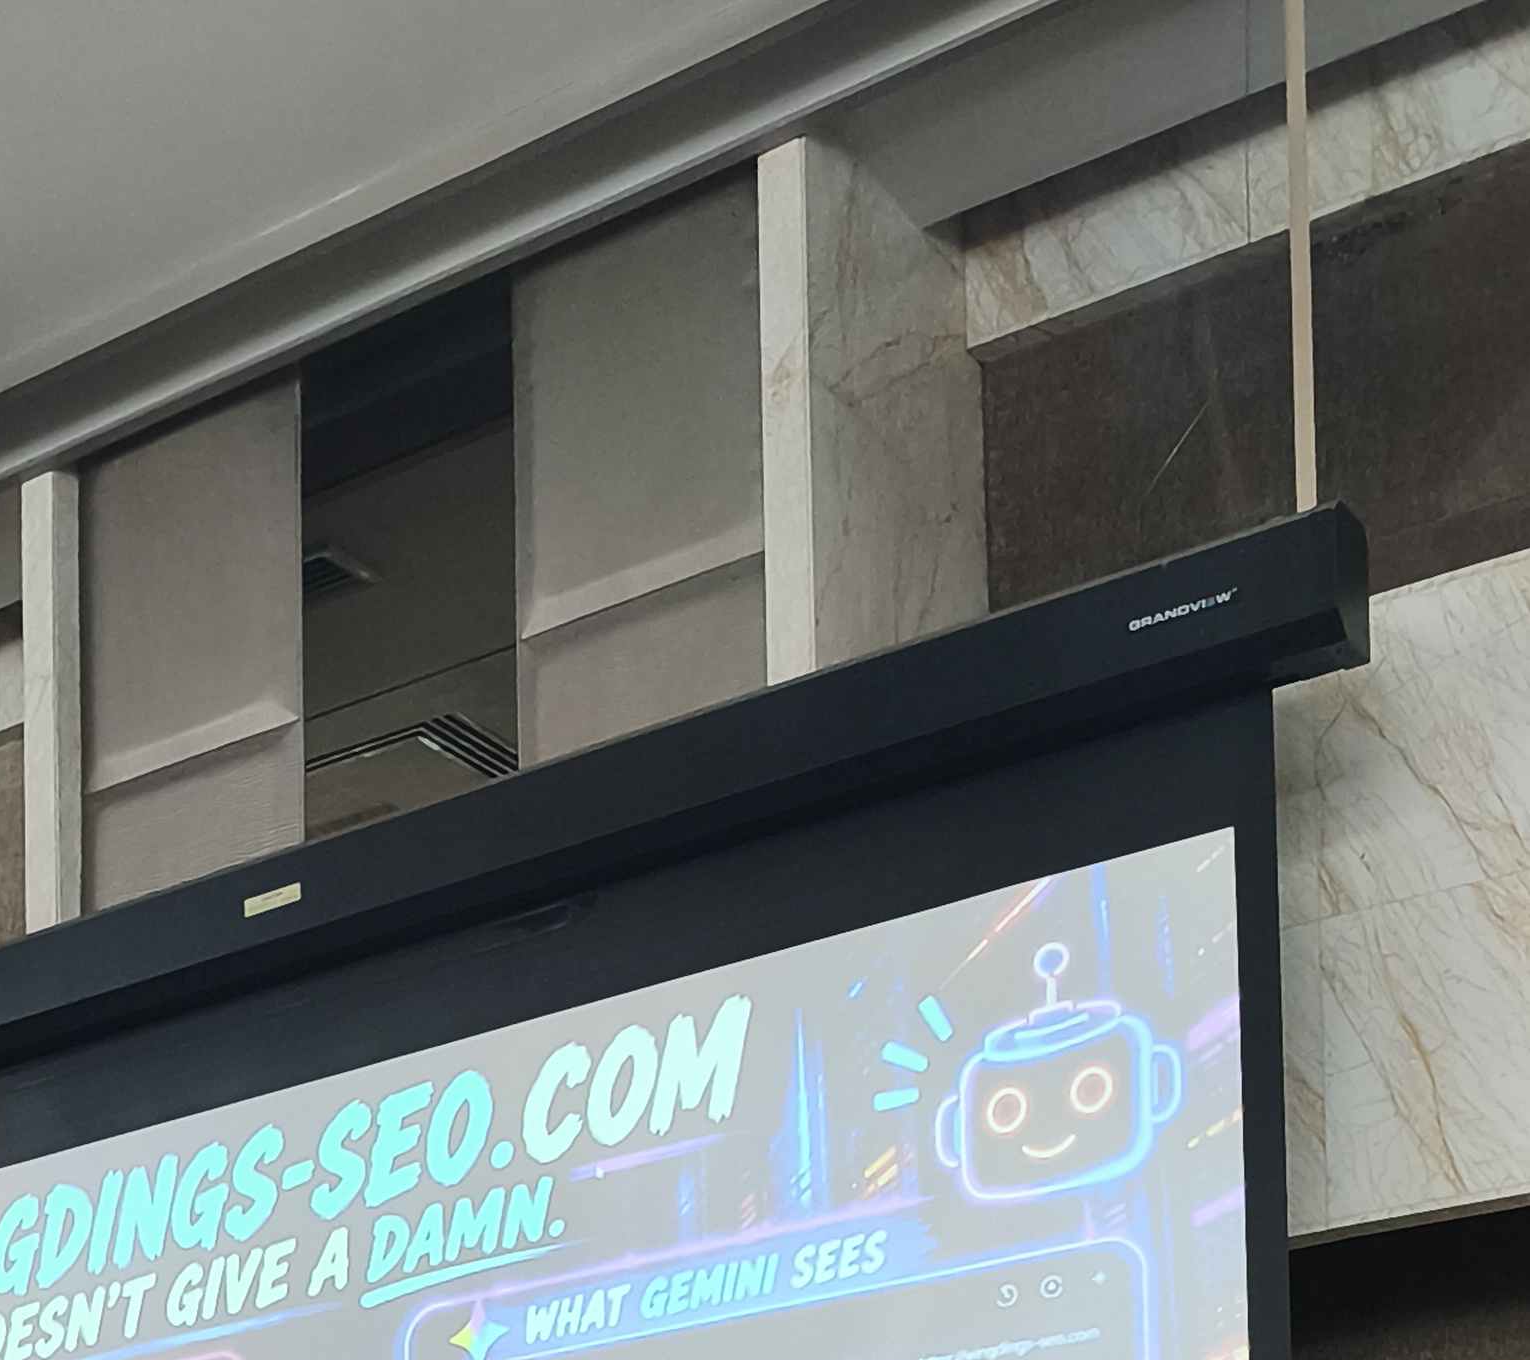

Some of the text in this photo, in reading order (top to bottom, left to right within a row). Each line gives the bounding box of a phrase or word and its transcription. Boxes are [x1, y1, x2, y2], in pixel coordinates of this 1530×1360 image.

[165, 1236, 299, 1325] GIVE
[307, 1227, 352, 1297] A
[366, 1176, 570, 1285] DAMN.
[525, 1230, 888, 1345] WHAT GEMINI SEES
